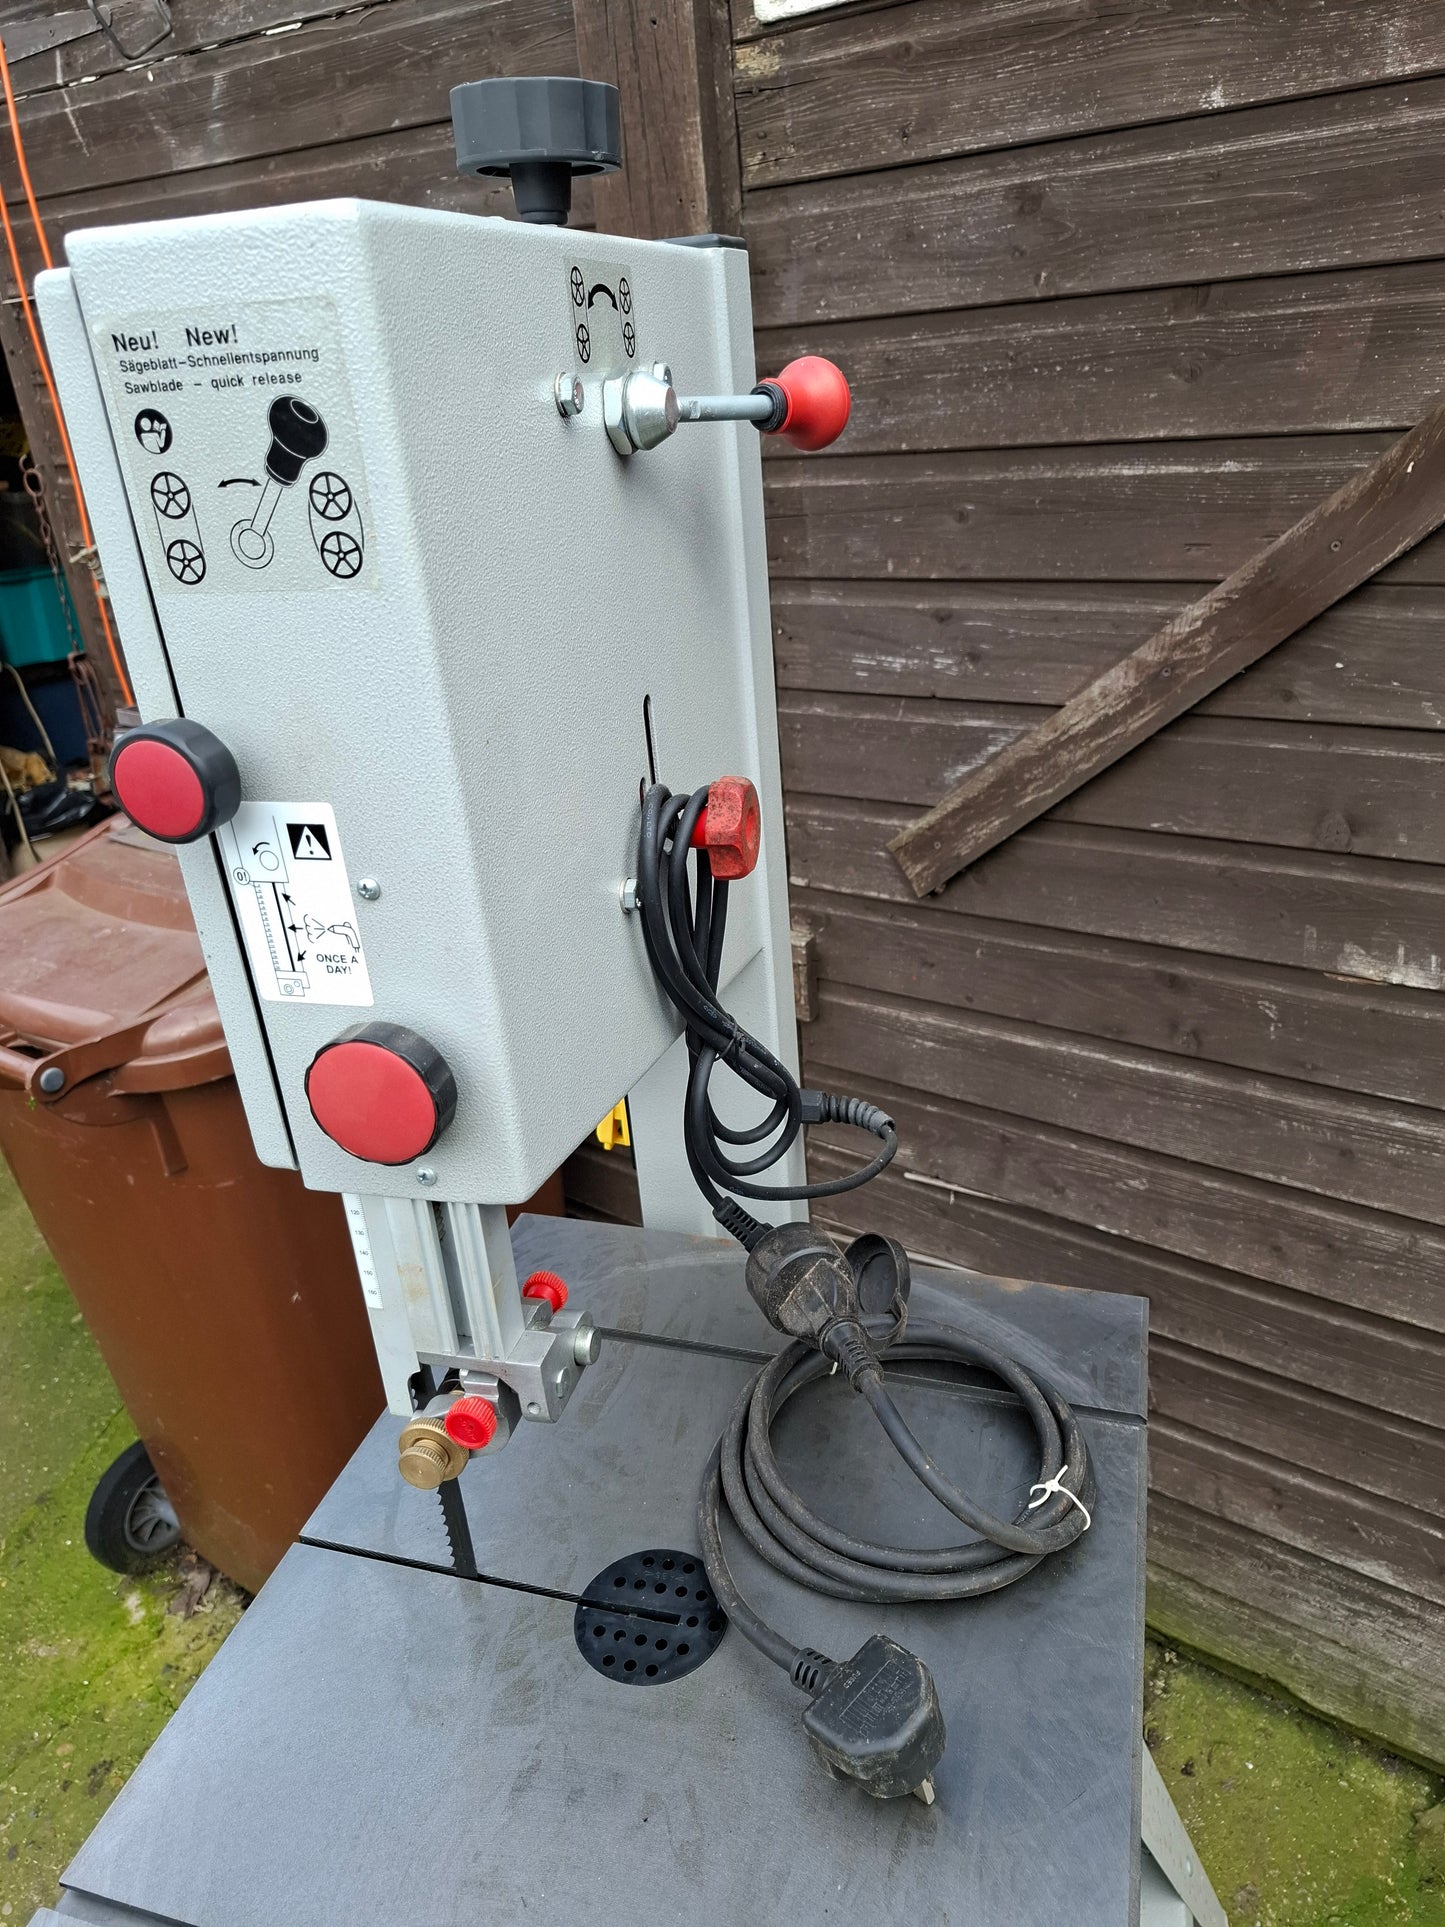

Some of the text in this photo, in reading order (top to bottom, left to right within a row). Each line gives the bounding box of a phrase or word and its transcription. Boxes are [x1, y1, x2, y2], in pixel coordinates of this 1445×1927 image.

[111, 324, 238, 352] Neu! New!
[124, 379, 183, 395] Sawblade
[211, 374, 245, 392] quick
[252, 372, 302, 386] release
[316, 953, 359, 964] ONCE A
[326, 964, 352, 975] DAY!
